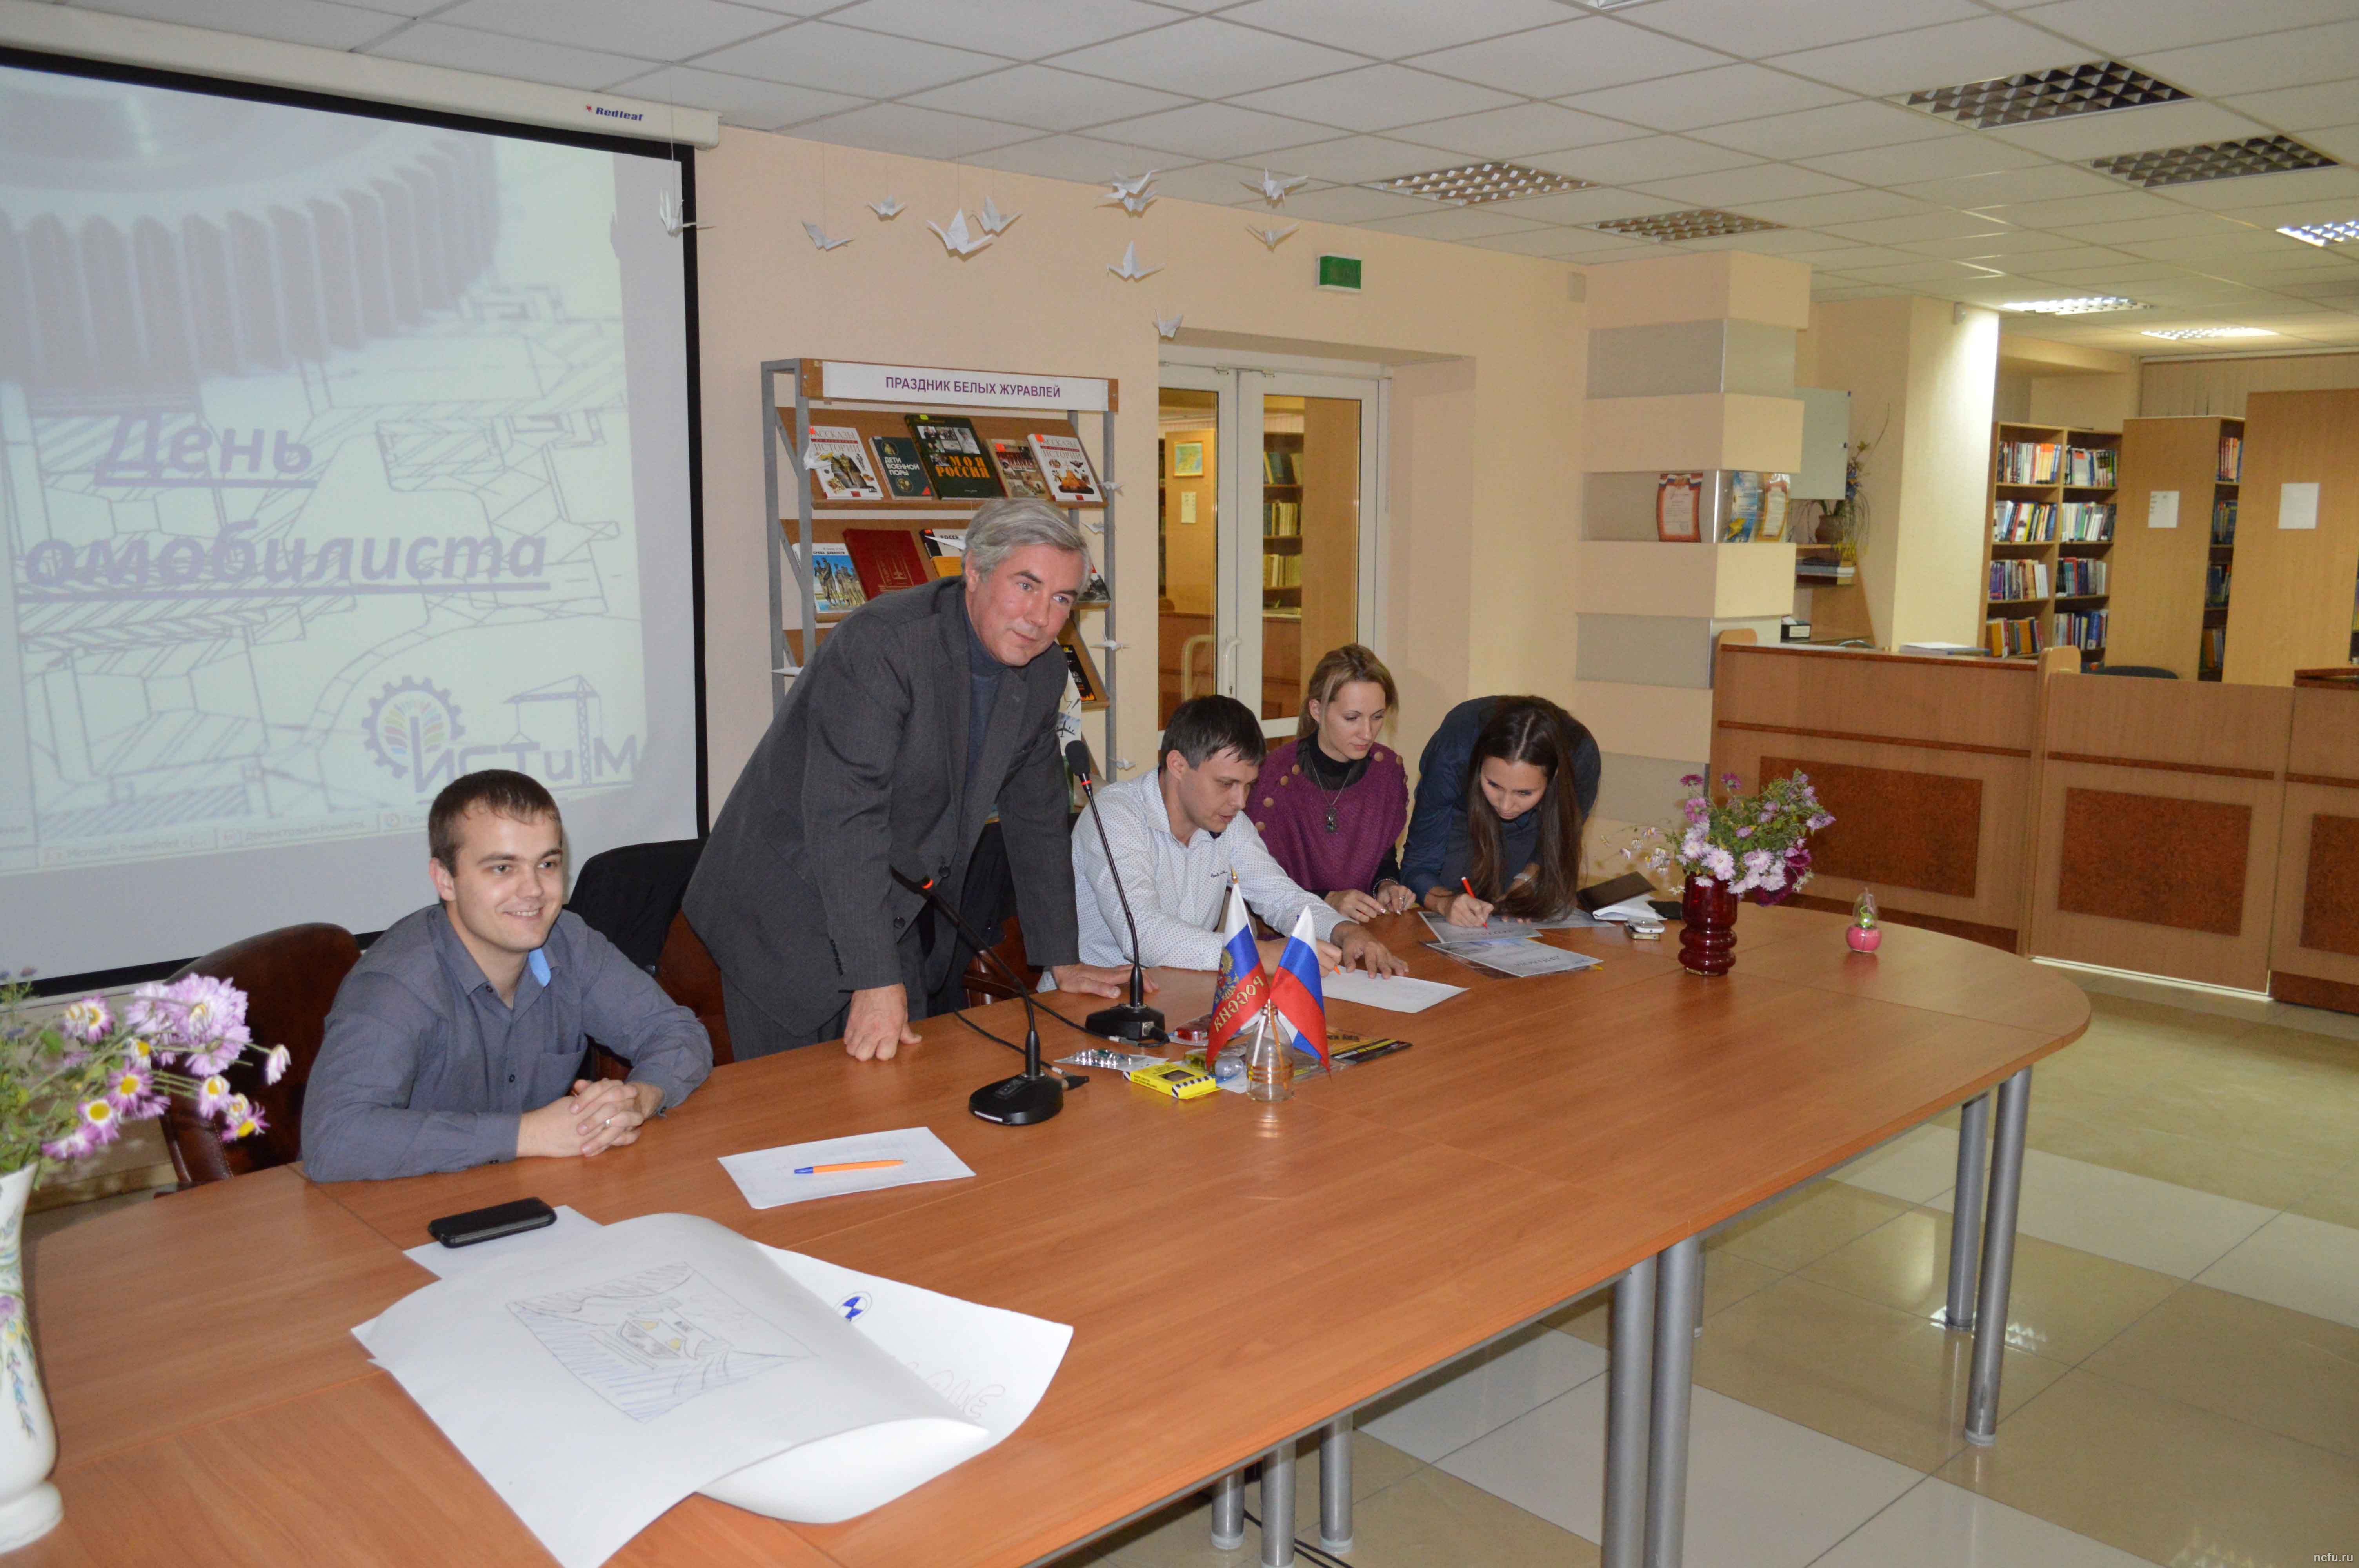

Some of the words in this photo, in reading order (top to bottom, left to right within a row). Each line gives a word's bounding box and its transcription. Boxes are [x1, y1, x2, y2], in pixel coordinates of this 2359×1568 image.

[596, 107, 643, 121] Redleaf
[885, 377, 951, 392] ПРАЗДНИК
[954, 381, 996, 394] БЕЛЫХ
[999, 383, 1060, 397] ЖУРАВЛЕЙ
[95, 408, 313, 486] День
[1041, 438, 1078, 447] АССКАЗЫ
[948, 456, 986, 467] МОЯ
[935, 464, 990, 478] РОССИЯ
